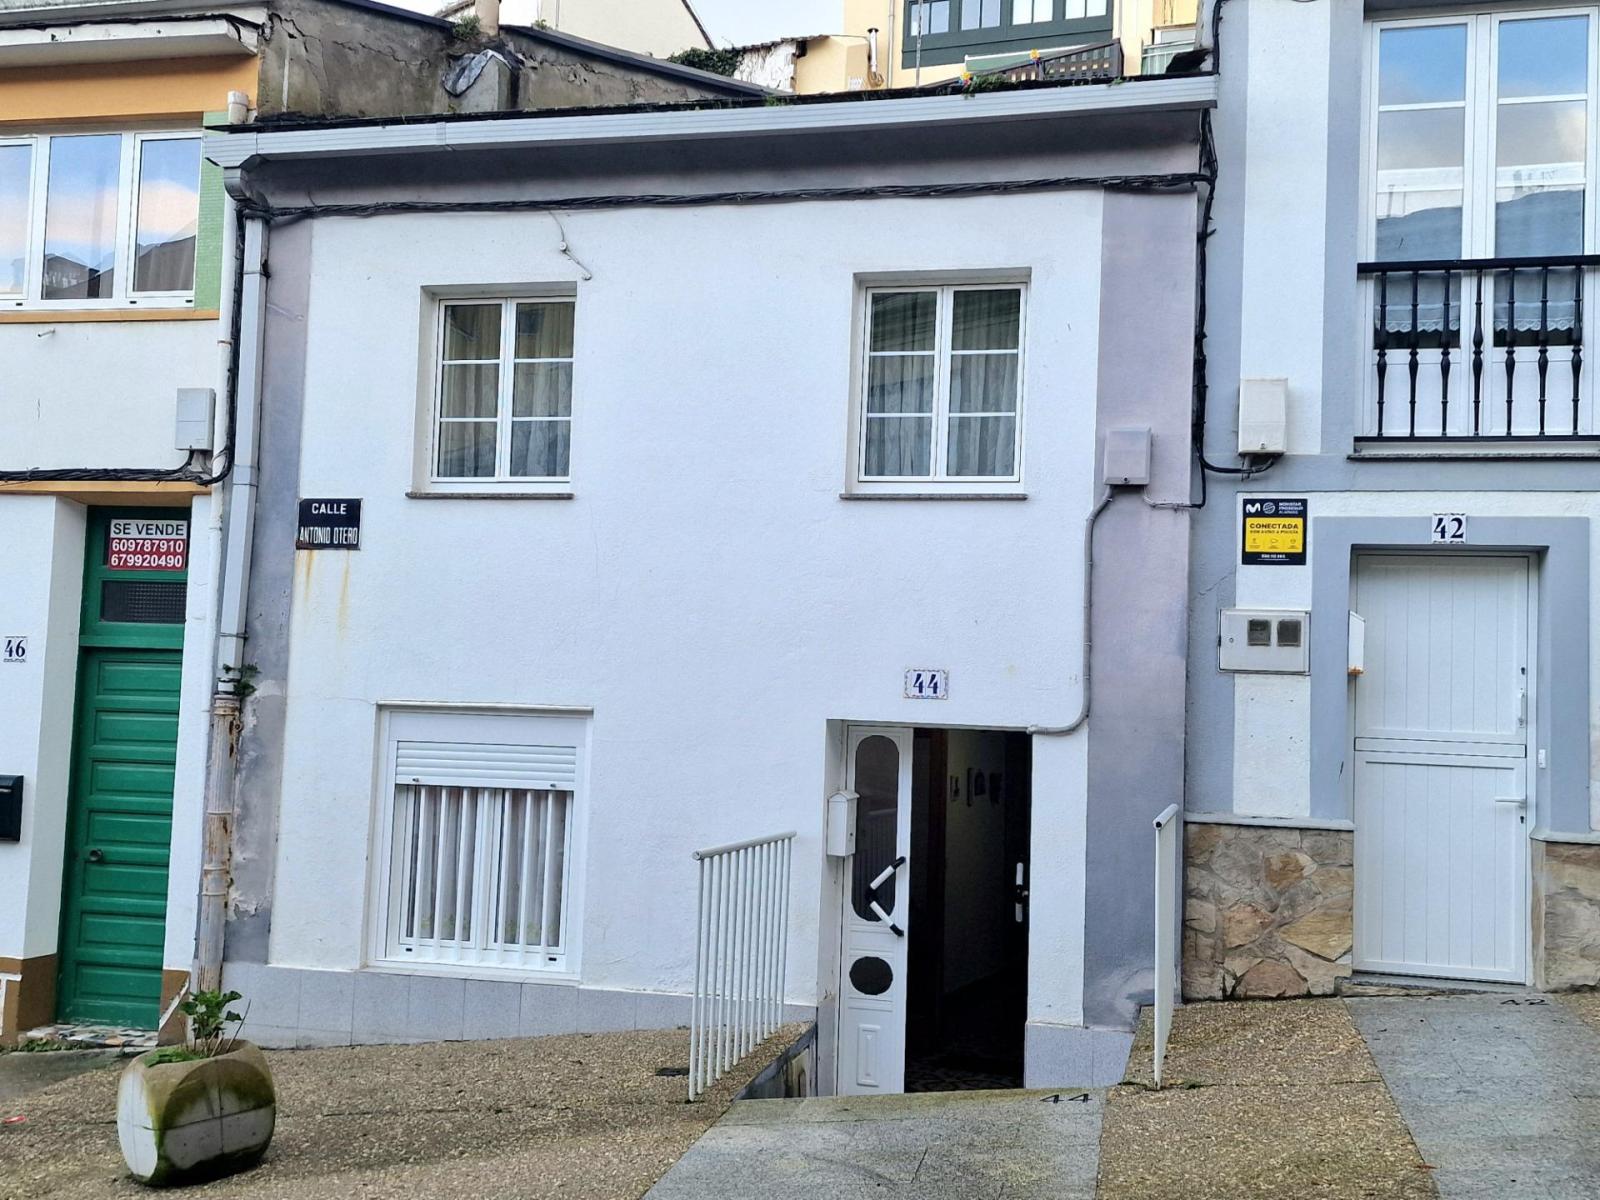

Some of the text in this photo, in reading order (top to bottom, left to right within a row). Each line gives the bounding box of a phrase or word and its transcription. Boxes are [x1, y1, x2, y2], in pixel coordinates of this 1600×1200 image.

[311, 503, 347, 515] CALLE
[113, 523, 185, 536] SE VENDE
[299, 526, 358, 545] ANTONIO OTERO
[1433, 517, 1464, 539] 42
[112, 539, 184, 553] 609787910
[110, 554, 183, 568] 679920490
[4, 639, 26, 658] 46
[912, 672, 939, 694] 44
